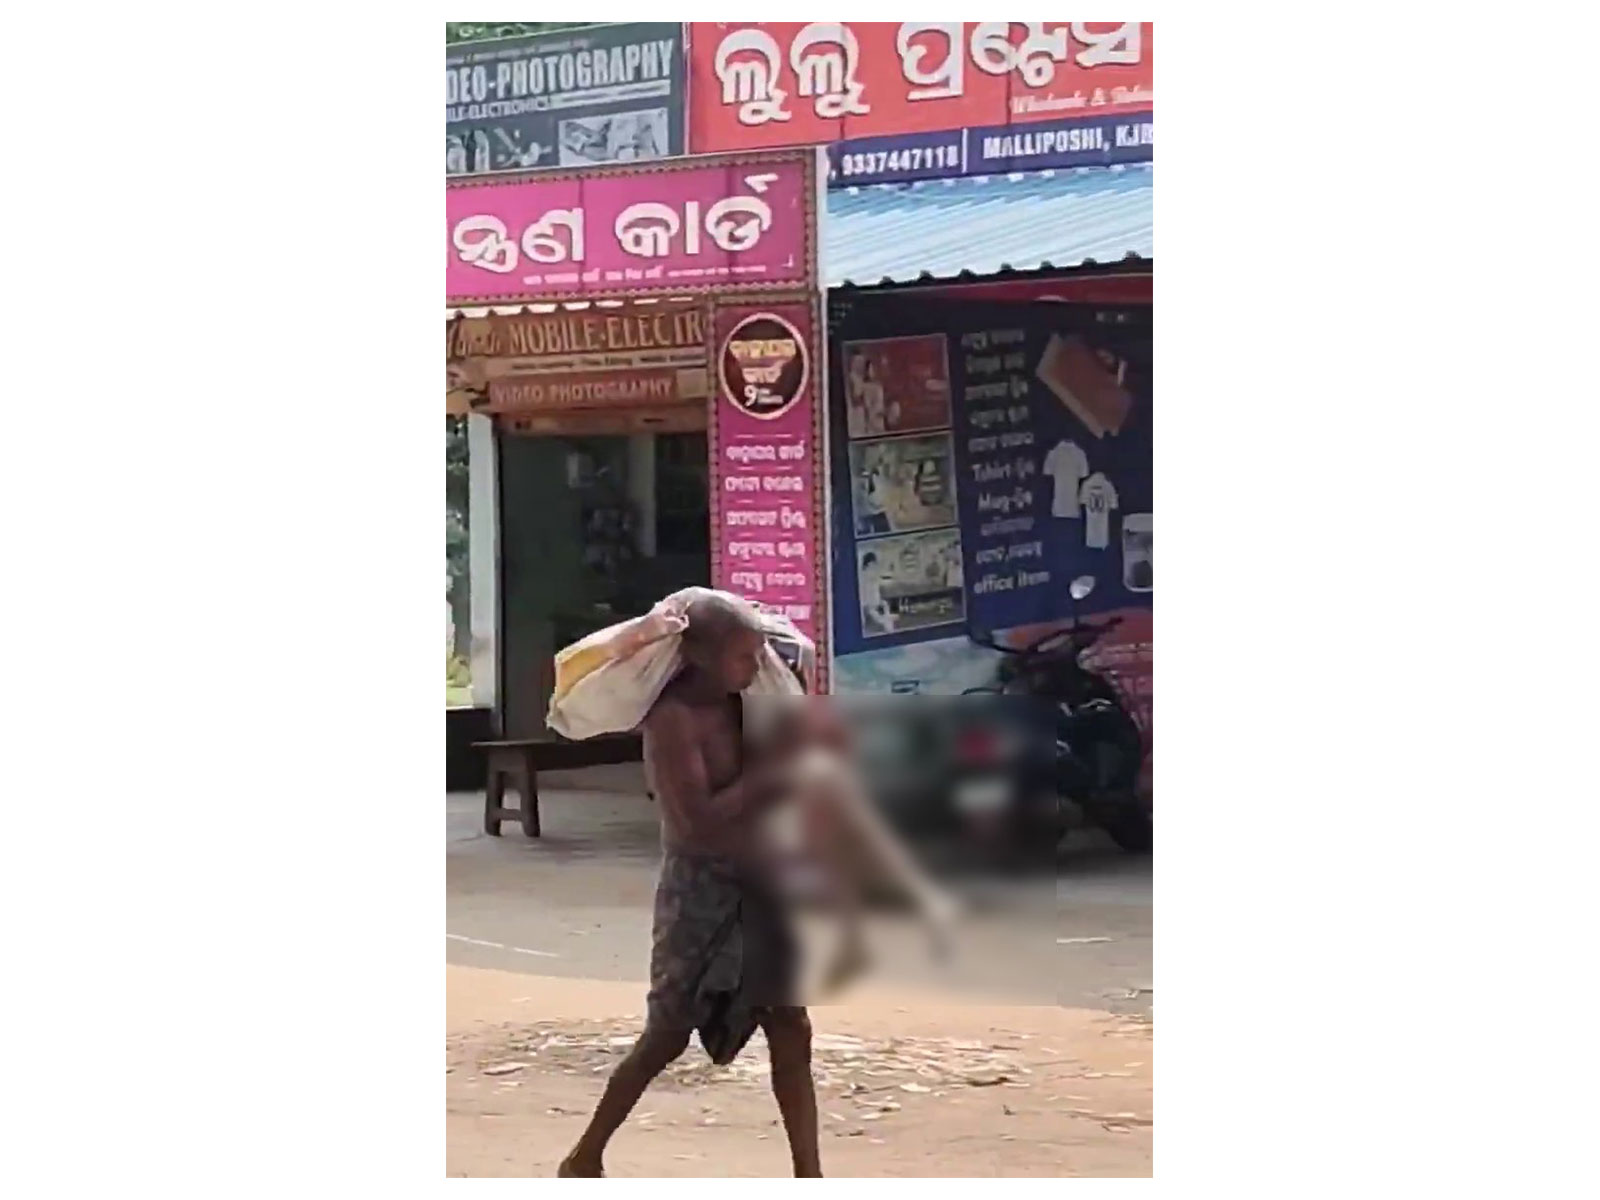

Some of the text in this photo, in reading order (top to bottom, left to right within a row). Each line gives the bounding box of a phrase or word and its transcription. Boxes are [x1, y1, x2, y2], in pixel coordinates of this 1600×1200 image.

[715, 27, 870, 125] ଲୁଲୁ
[493, 377, 672, 404] VIDEO PHOTOGRAPHY
